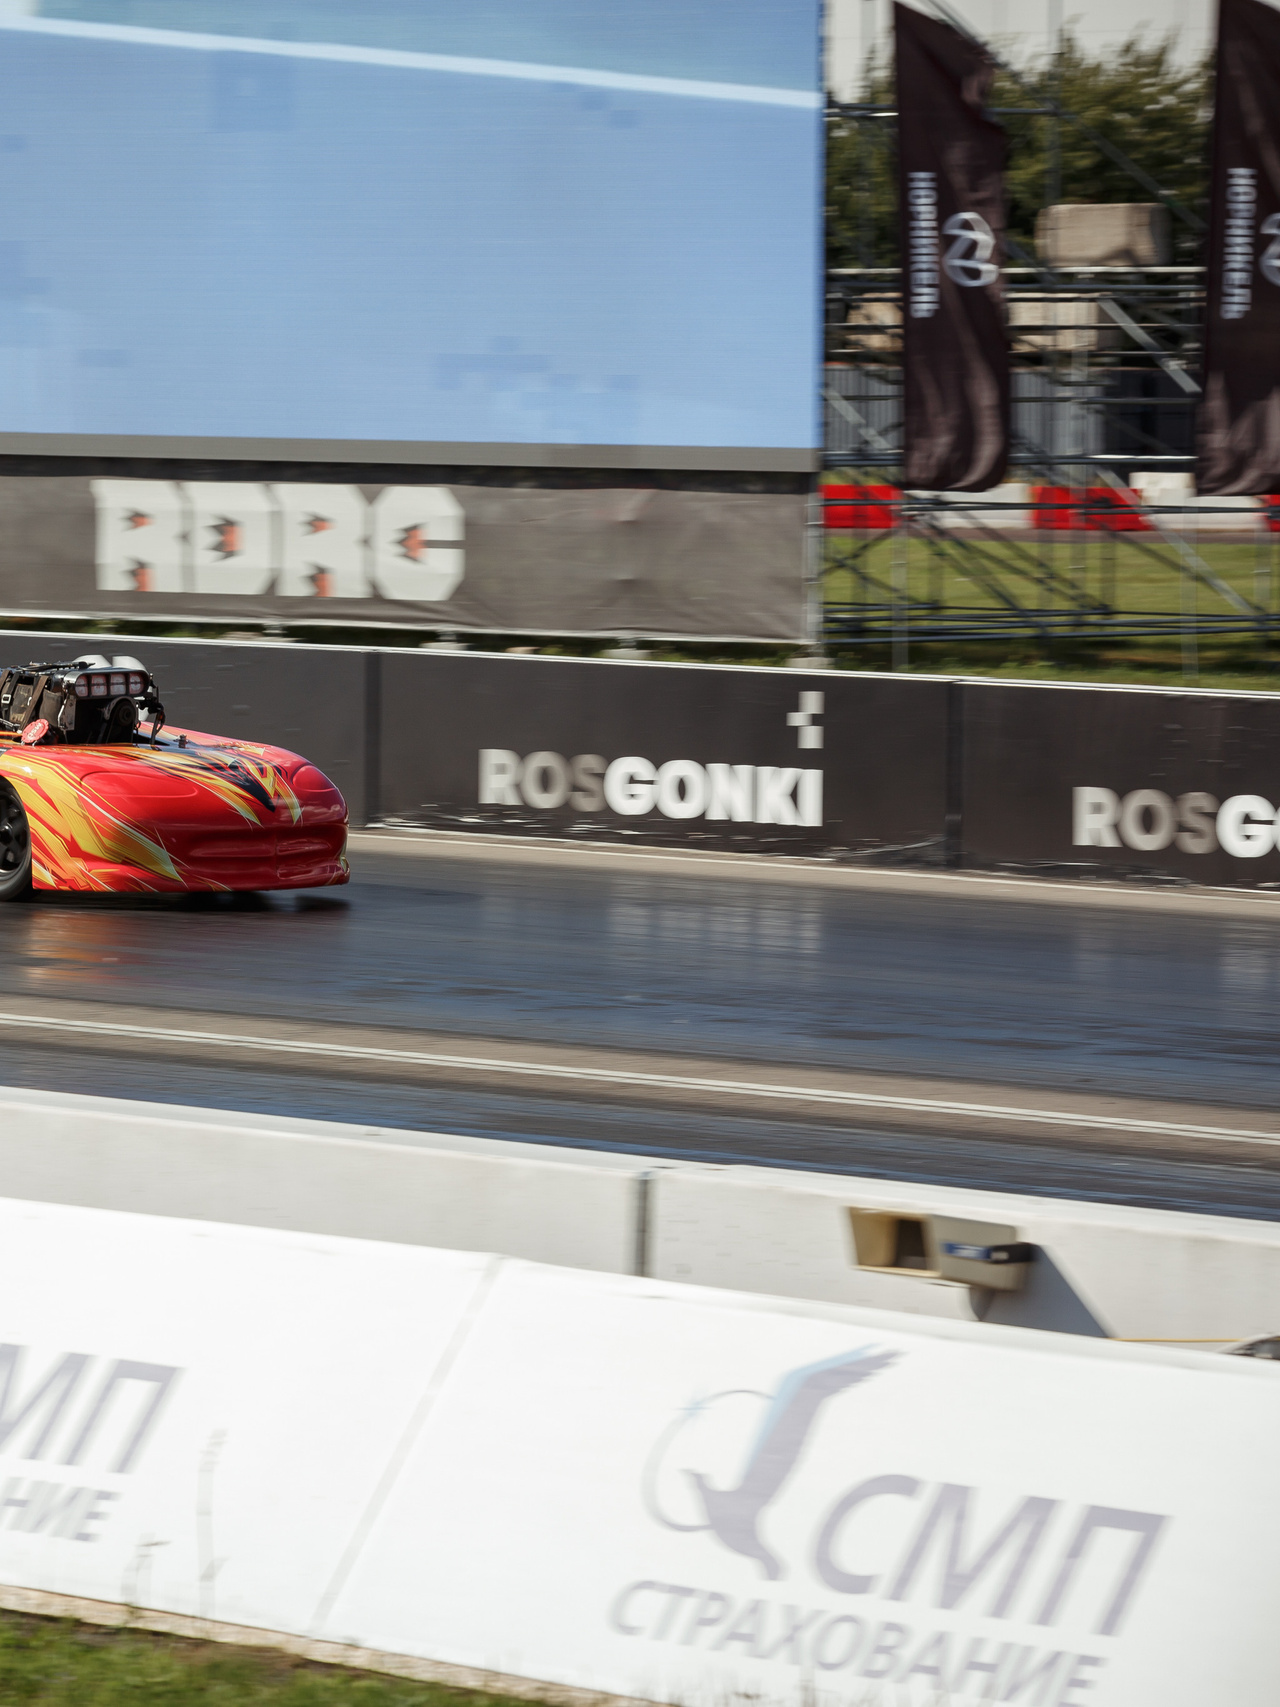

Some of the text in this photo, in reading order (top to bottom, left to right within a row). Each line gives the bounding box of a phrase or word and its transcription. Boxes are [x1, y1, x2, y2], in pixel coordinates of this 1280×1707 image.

[90, 479, 465, 601] RDRC
[478, 748, 824, 827] ROSGONKI
[1072, 786, 1280, 858] ROSG
[808, 1473, 1174, 1637] СМП
[606, 1579, 1109, 1707] СТРАХОВАНИЕ
